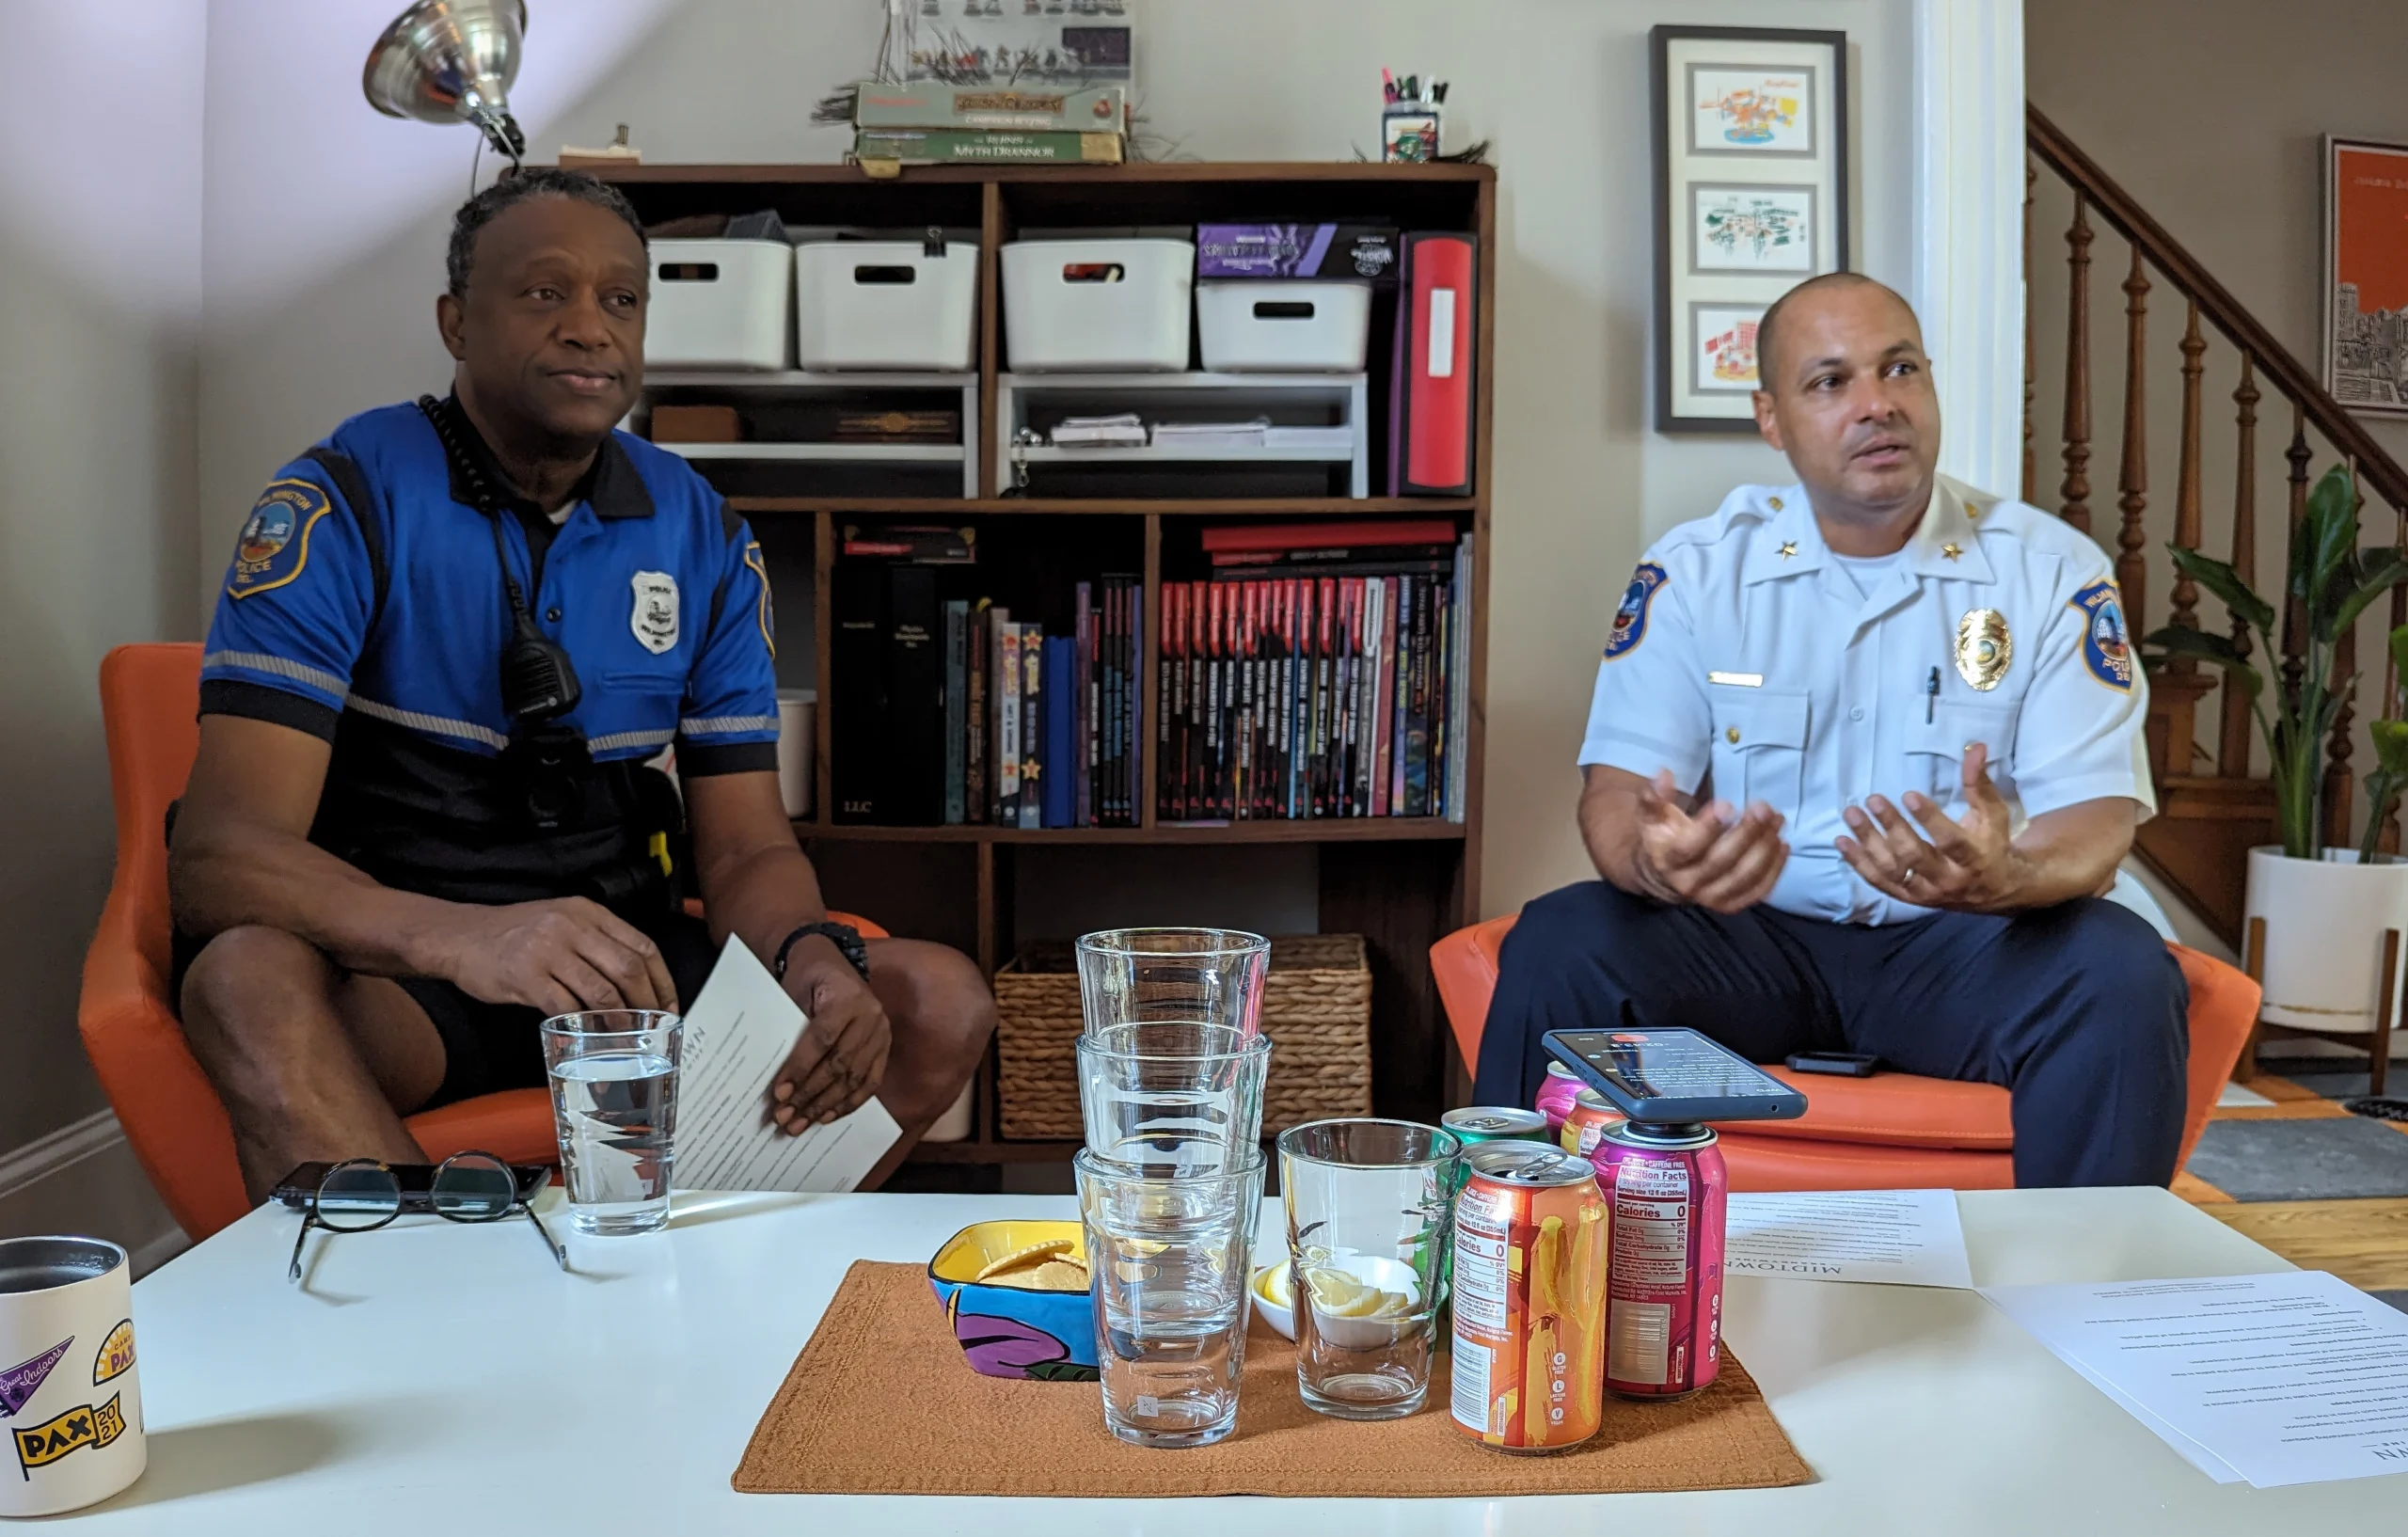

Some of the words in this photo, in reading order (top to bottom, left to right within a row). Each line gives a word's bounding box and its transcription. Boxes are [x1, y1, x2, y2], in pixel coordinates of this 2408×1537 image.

[1662, 1171, 1687, 1180] Facts
[1617, 1185, 1635, 1195] Serving
[1616, 1204, 1660, 1218] Calories
[1677, 1205, 1686, 1217] 0
[1456, 1233, 1481, 1253] Calories
[1497, 1244, 1504, 1258] 0
[1723, 1260, 1841, 1275] MIDTOWN
[110, 1343, 135, 1373] PAX
[0, 1373, 24, 1395] Great
[20, 1348, 63, 1386] Indoors
[98, 1403, 116, 1425] 20
[23, 1415, 92, 1458] PAX
[101, 1420, 118, 1440] 21
